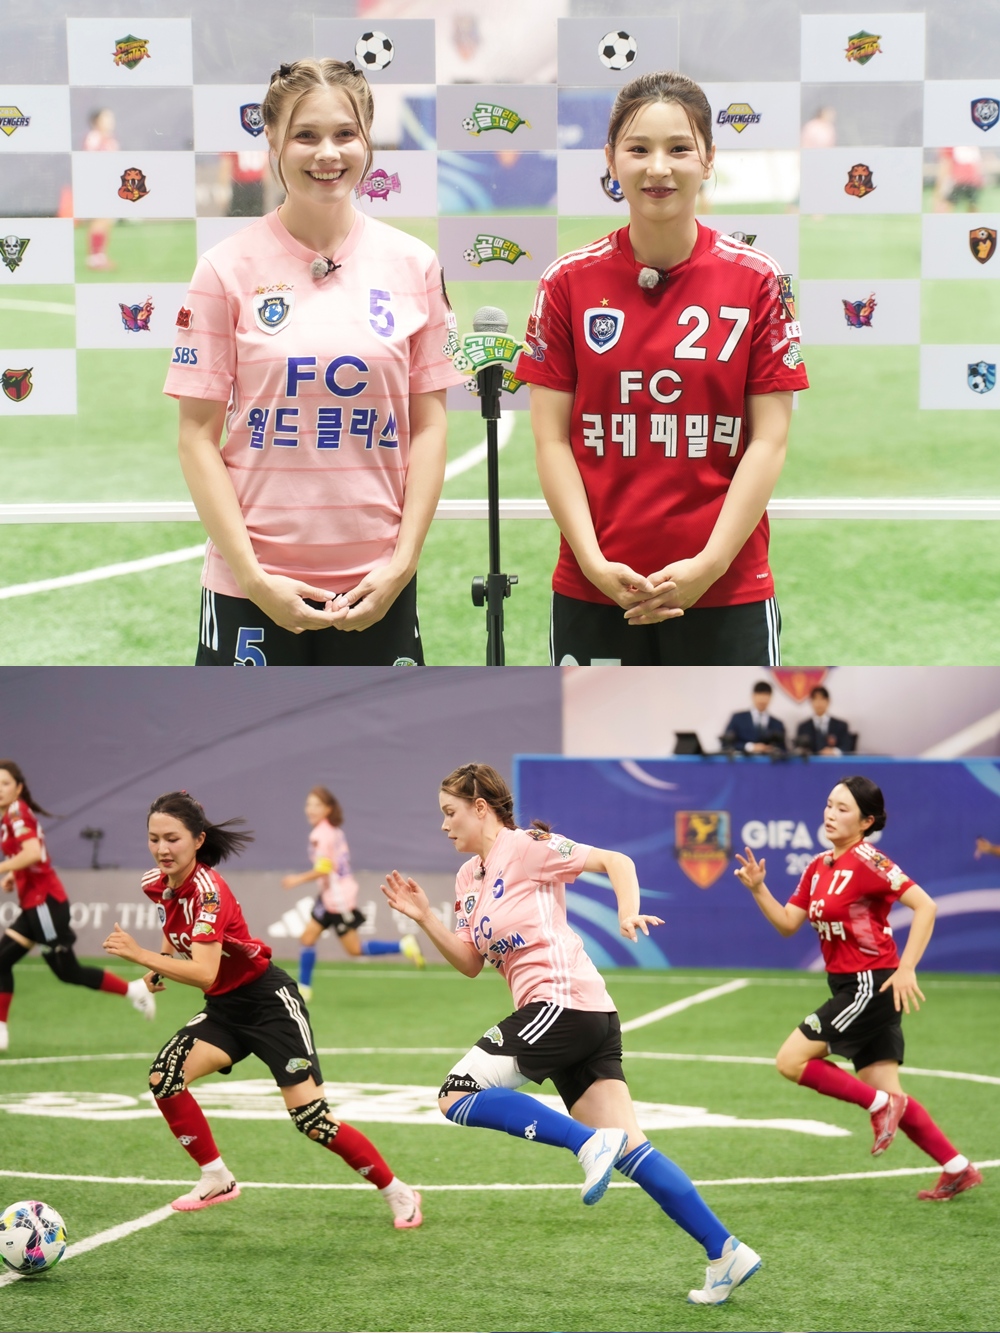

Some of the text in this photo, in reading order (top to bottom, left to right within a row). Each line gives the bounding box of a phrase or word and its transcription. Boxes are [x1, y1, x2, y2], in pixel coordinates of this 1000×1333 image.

[370, 288, 395, 338] 5
[674, 305, 750, 362] 27
[172, 346, 198, 365] SBS
[286, 355, 369, 398] FC
[619, 369, 682, 404] FC
[582, 413, 742, 458] 국대 패밀리
[742, 820, 813, 850] GIFA
[827, 869, 853, 895] 17
[808, 898, 825, 919] FC
